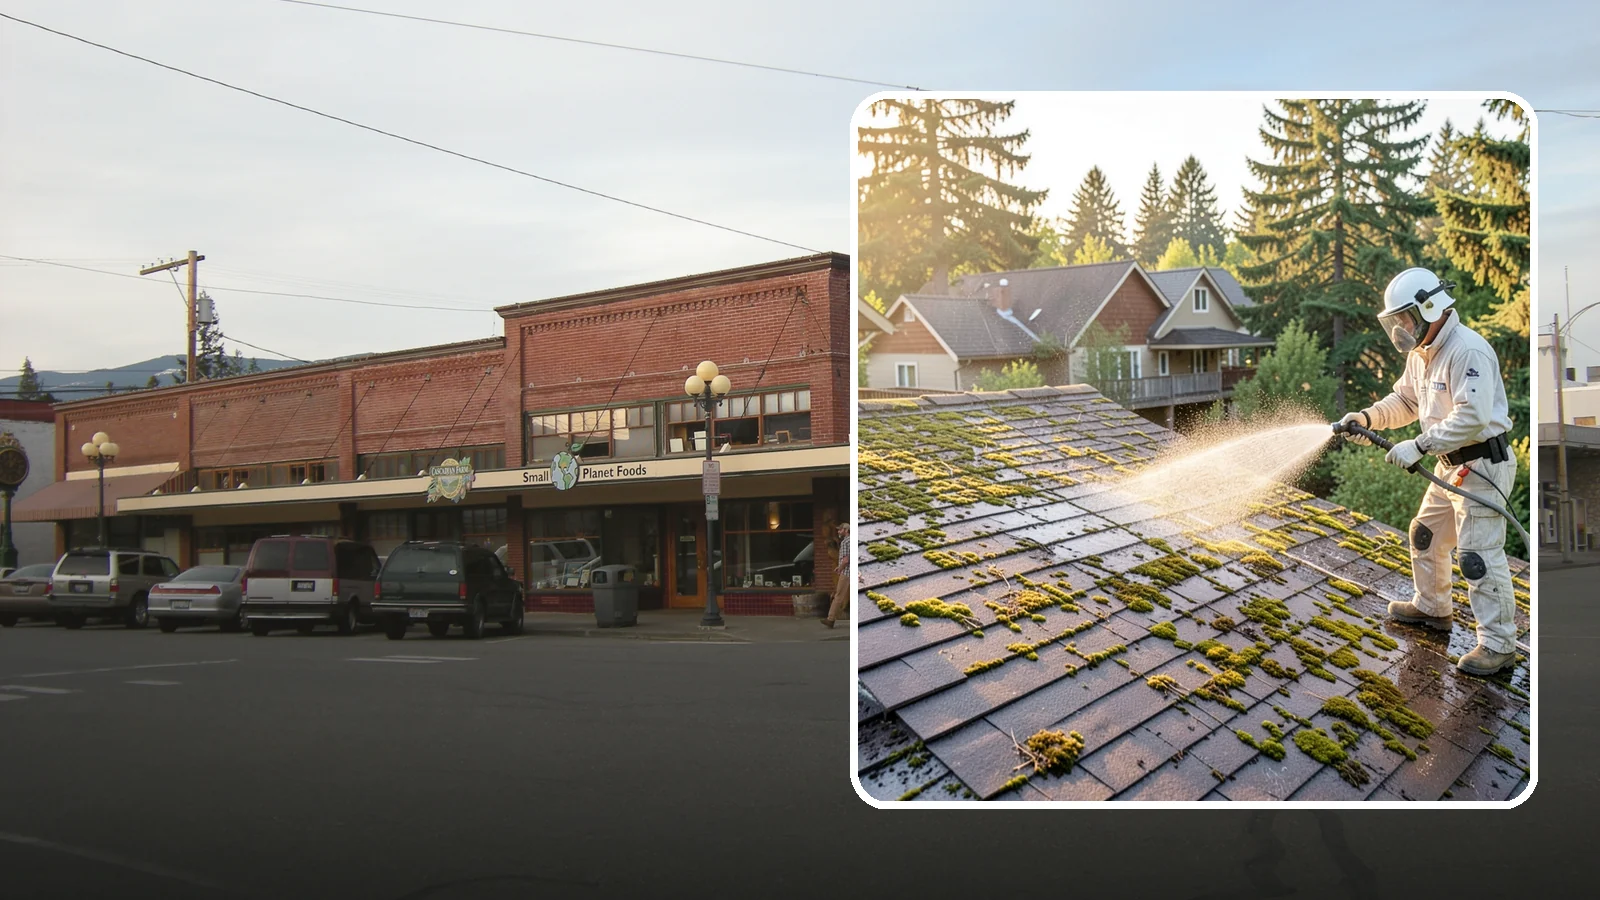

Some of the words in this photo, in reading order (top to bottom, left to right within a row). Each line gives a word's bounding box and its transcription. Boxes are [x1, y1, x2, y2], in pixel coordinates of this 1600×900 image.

[523, 471, 549, 483] Small
[583, 468, 614, 479] Planet
[617, 464, 647, 477] Foods
